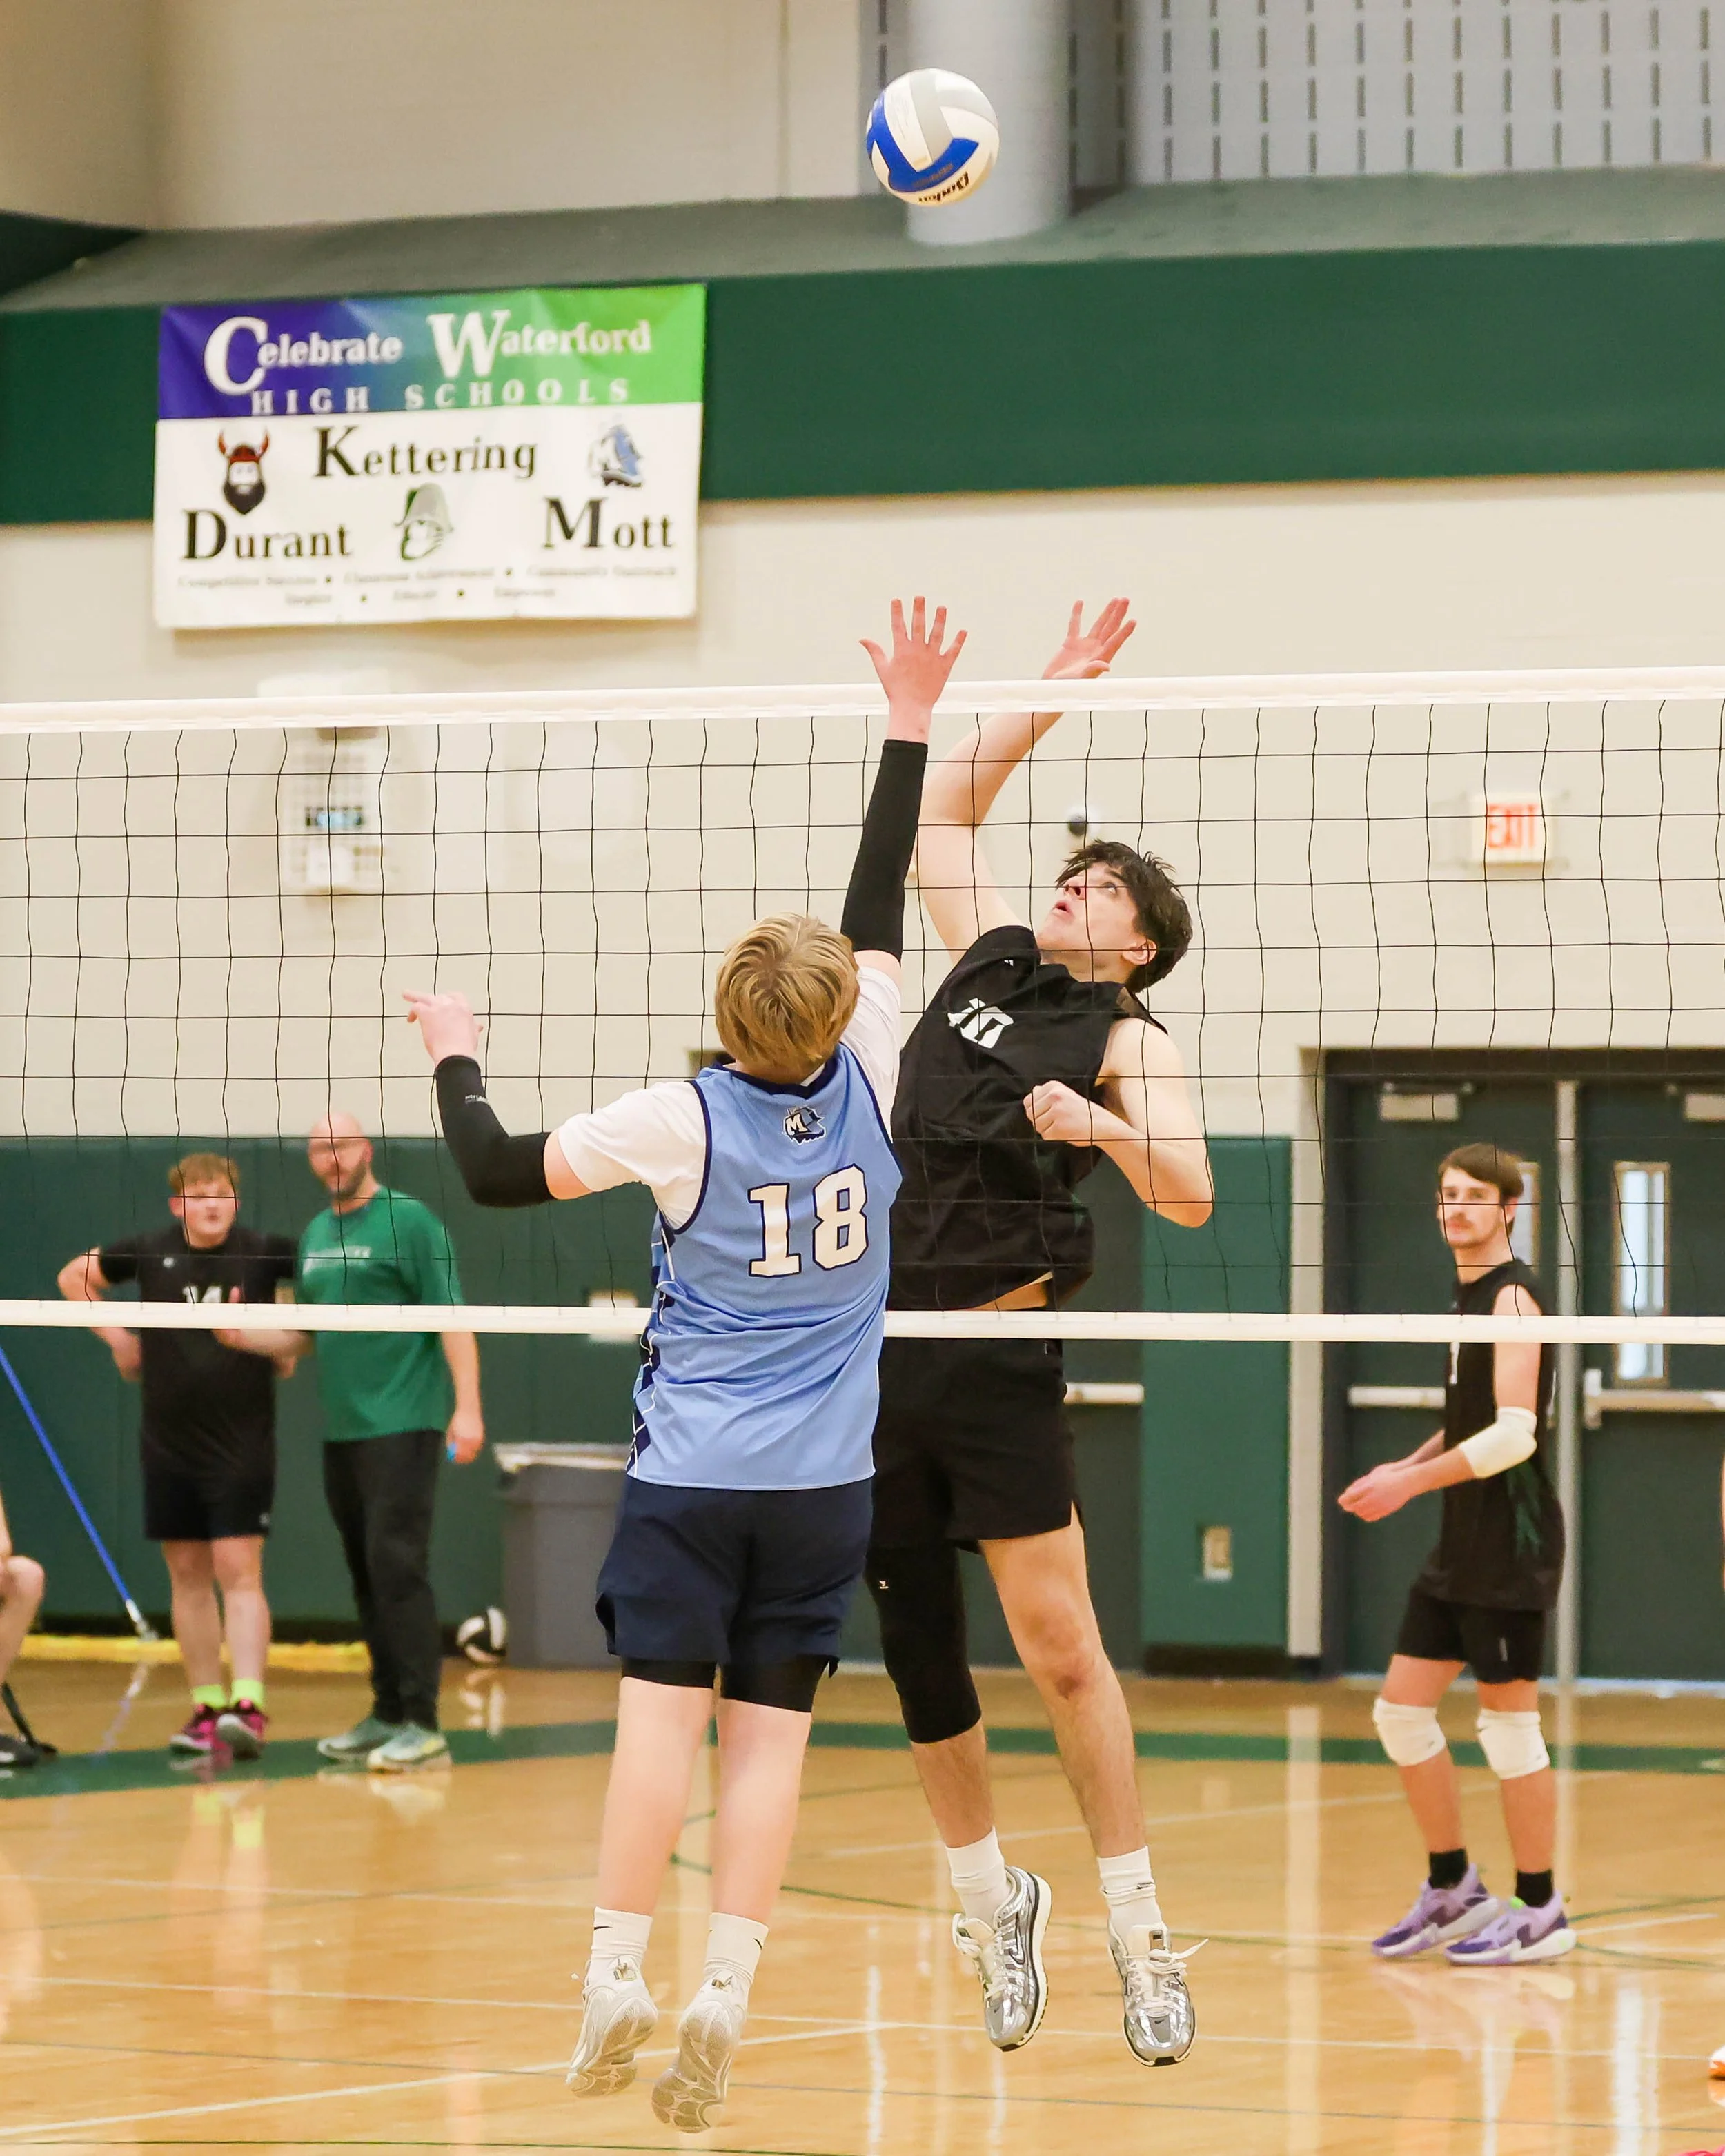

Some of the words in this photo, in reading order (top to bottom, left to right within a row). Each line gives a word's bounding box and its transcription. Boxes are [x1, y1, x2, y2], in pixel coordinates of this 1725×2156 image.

[204, 315, 404, 395] Celebrate
[426, 309, 651, 379] Waterford
[250, 386, 369, 415] HIGH
[404, 378, 629, 411] SCHOOLS
[314, 425, 537, 479] Kettering
[181, 509, 353, 560] Durant
[542, 496, 673, 548] Mott
[747, 1163, 869, 1277] 18
